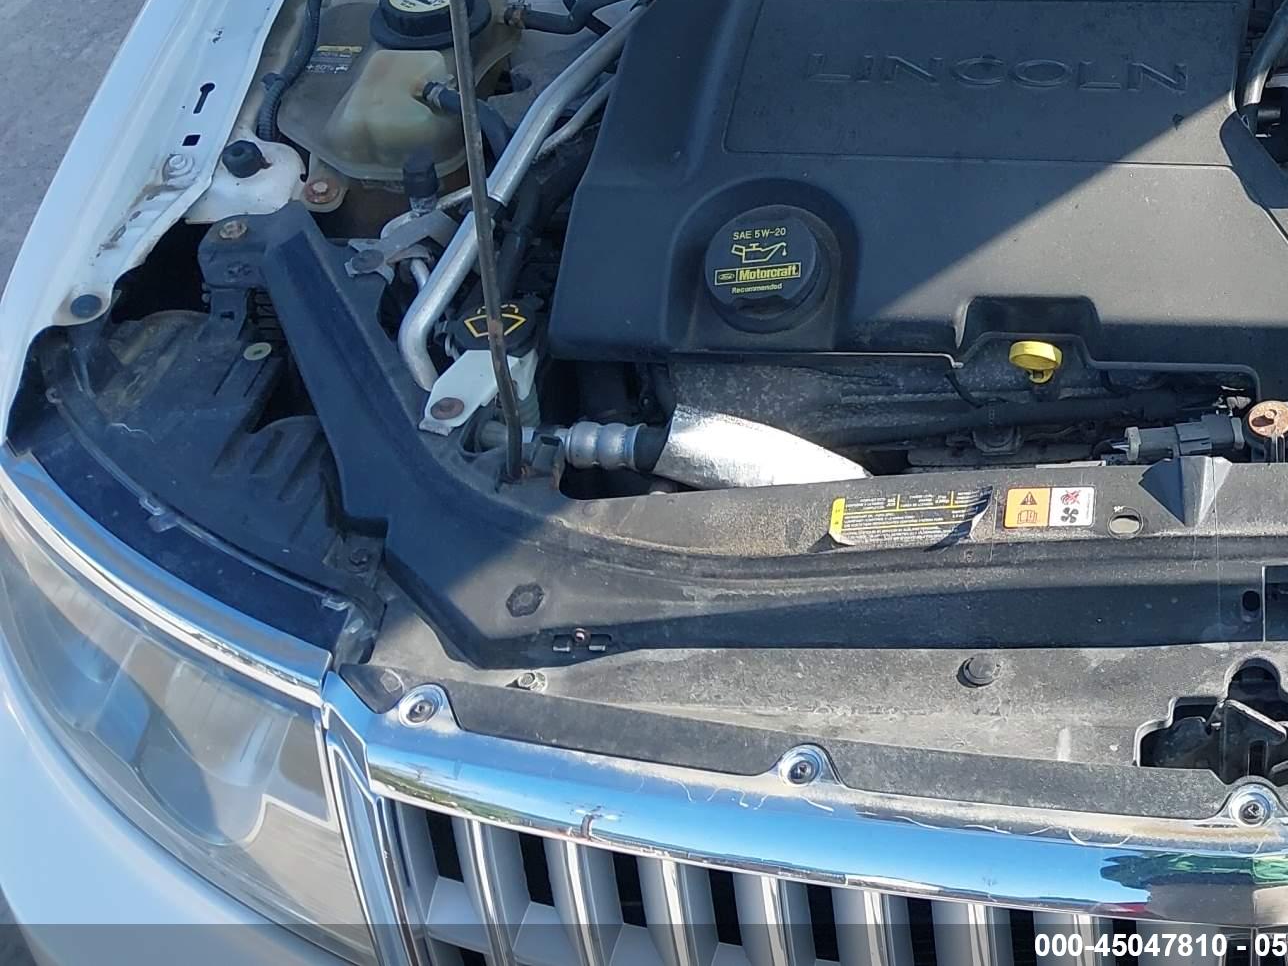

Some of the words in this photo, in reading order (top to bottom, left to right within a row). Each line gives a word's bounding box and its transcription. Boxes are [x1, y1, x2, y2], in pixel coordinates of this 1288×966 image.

[804, 52, 1190, 93] LINCOLN
[732, 229, 752, 241] SAE
[754, 227, 786, 240] 5W-20
[731, 282, 783, 294] Recommended
